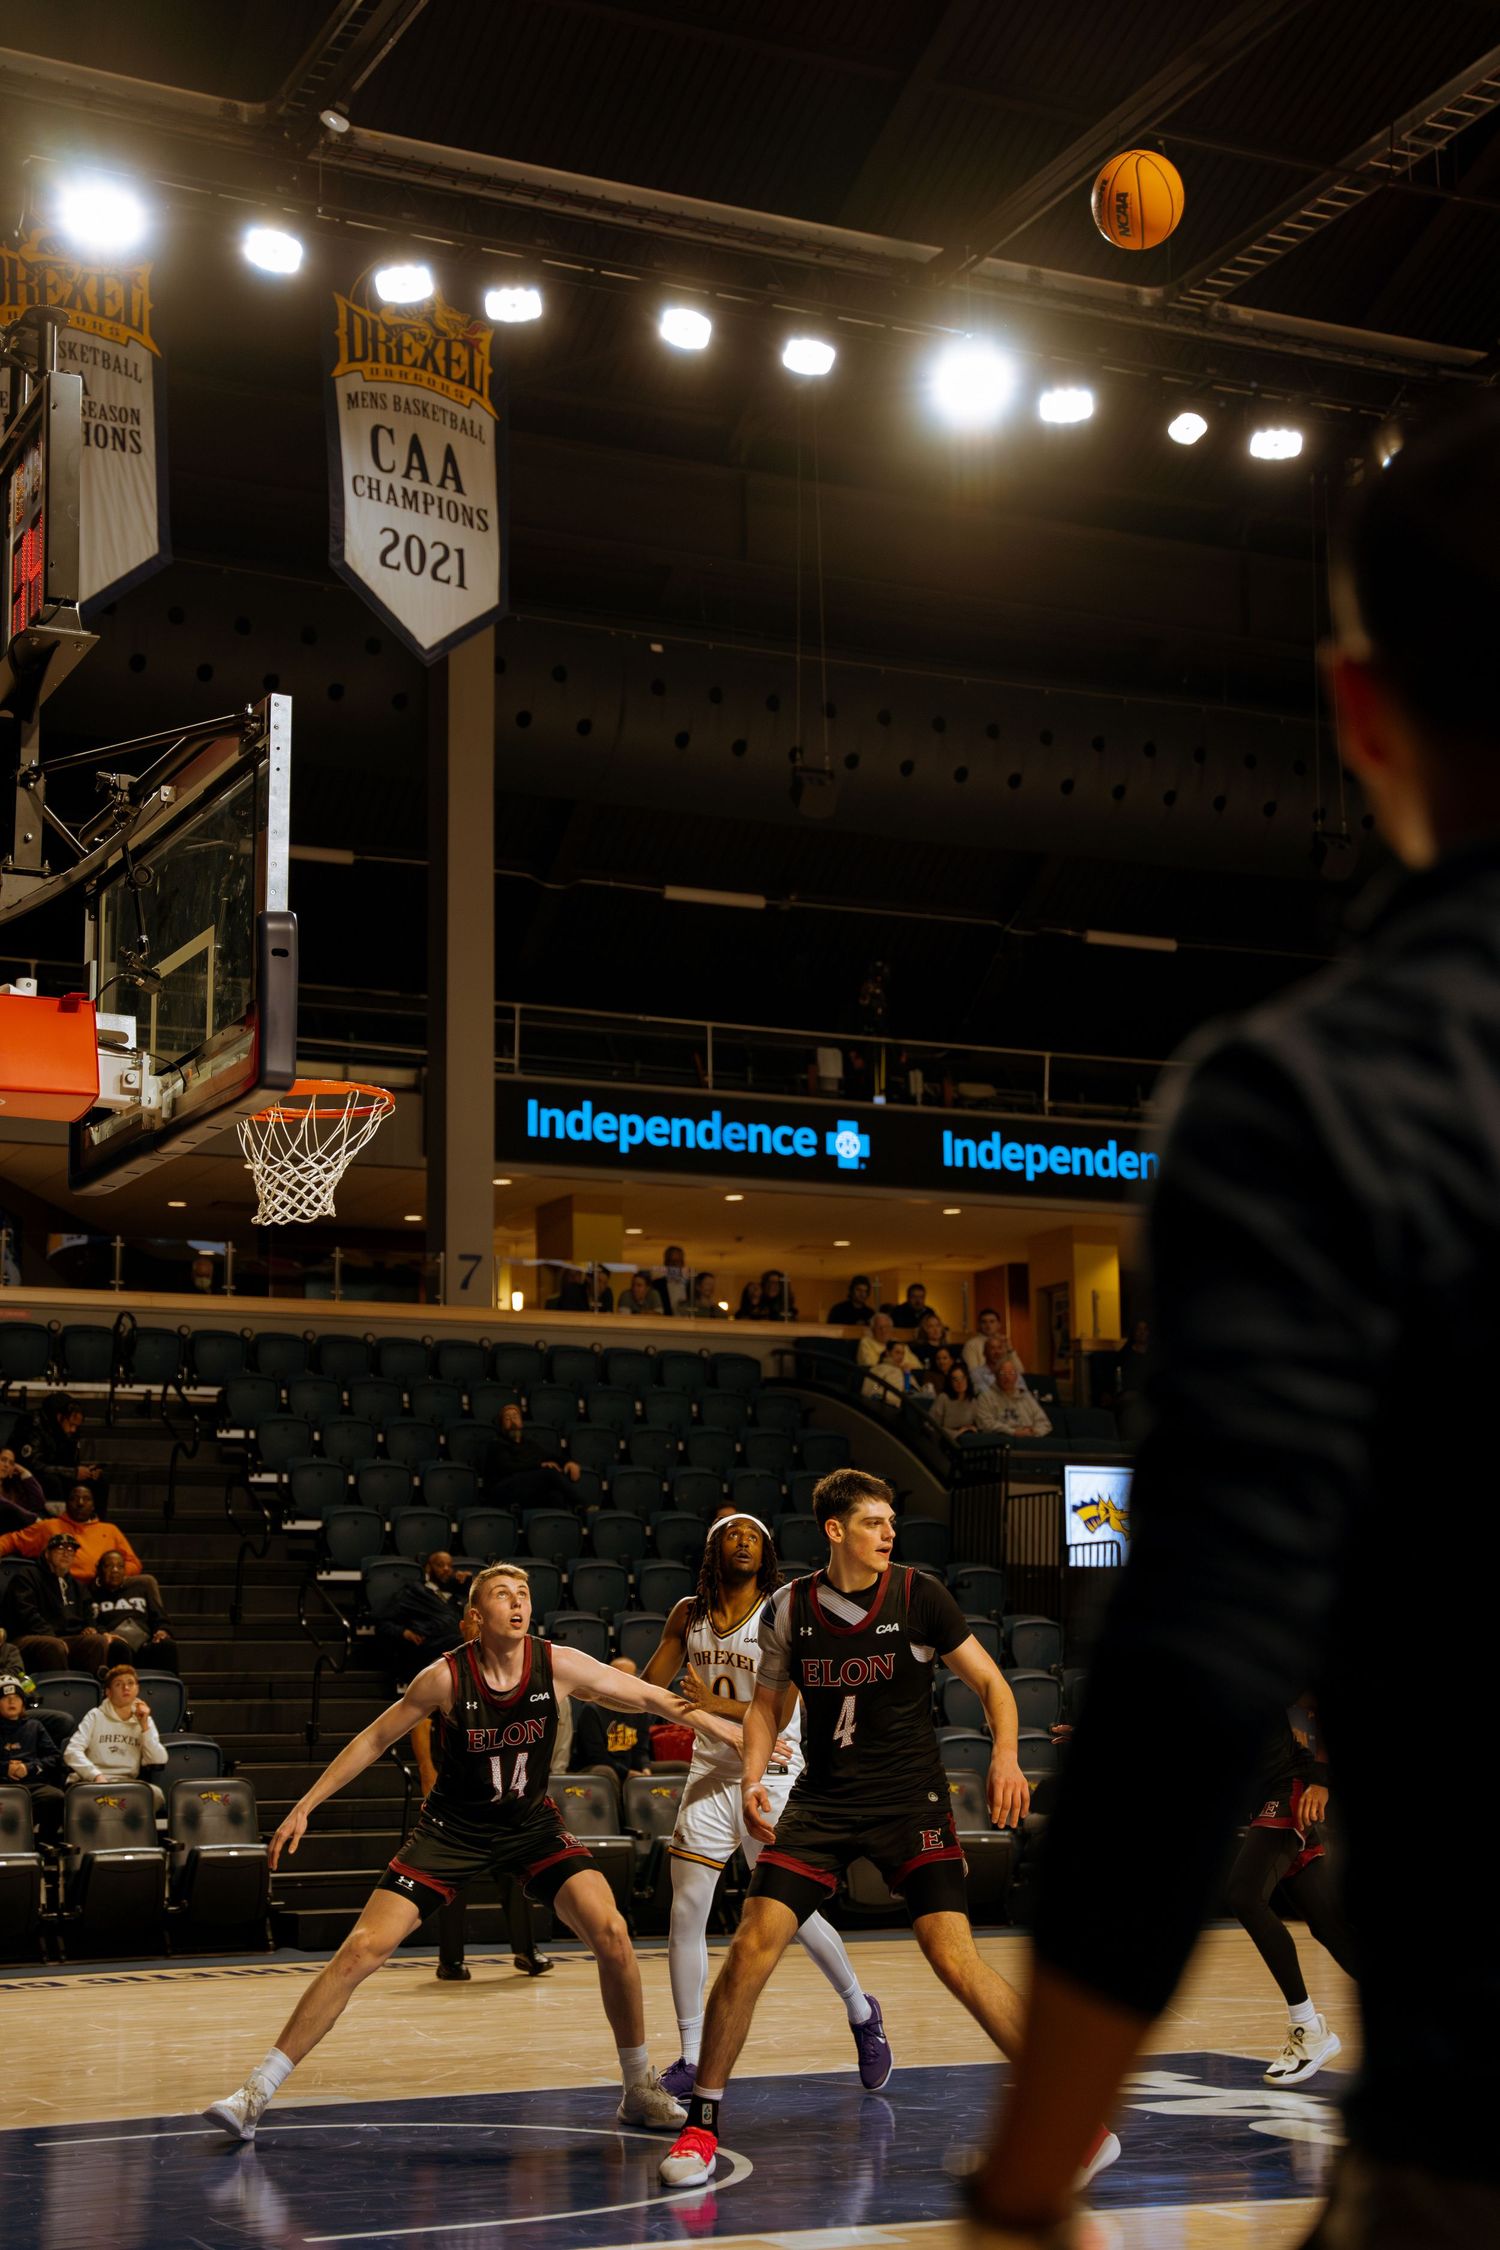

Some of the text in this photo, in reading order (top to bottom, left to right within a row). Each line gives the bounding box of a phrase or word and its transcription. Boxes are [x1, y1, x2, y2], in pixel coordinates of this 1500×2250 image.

[1115, 191, 1131, 237] NCAA
[0, 253, 147, 334] REXEL
[346, 304, 484, 398] DREXEL
[346, 391, 486, 445] MENS BASKETBALL
[370, 424, 467, 496] CAA
[352, 474, 489, 532] CHAMPIONS
[379, 527, 469, 590] 2021
[527, 1099, 817, 1158] Independence
[943, 1130, 1159, 1181] Independen
[458, 1254, 482, 1290] 7
[876, 1622, 899, 1634] CAA
[693, 1650, 757, 1674] DREXEL
[801, 1653, 896, 1687] ELON
[529, 1691, 550, 1702] CAA
[833, 1695, 857, 1748] 4
[466, 1716, 547, 1752] ELON
[489, 1752, 529, 1802] 14
[920, 1828, 944, 1851] E
